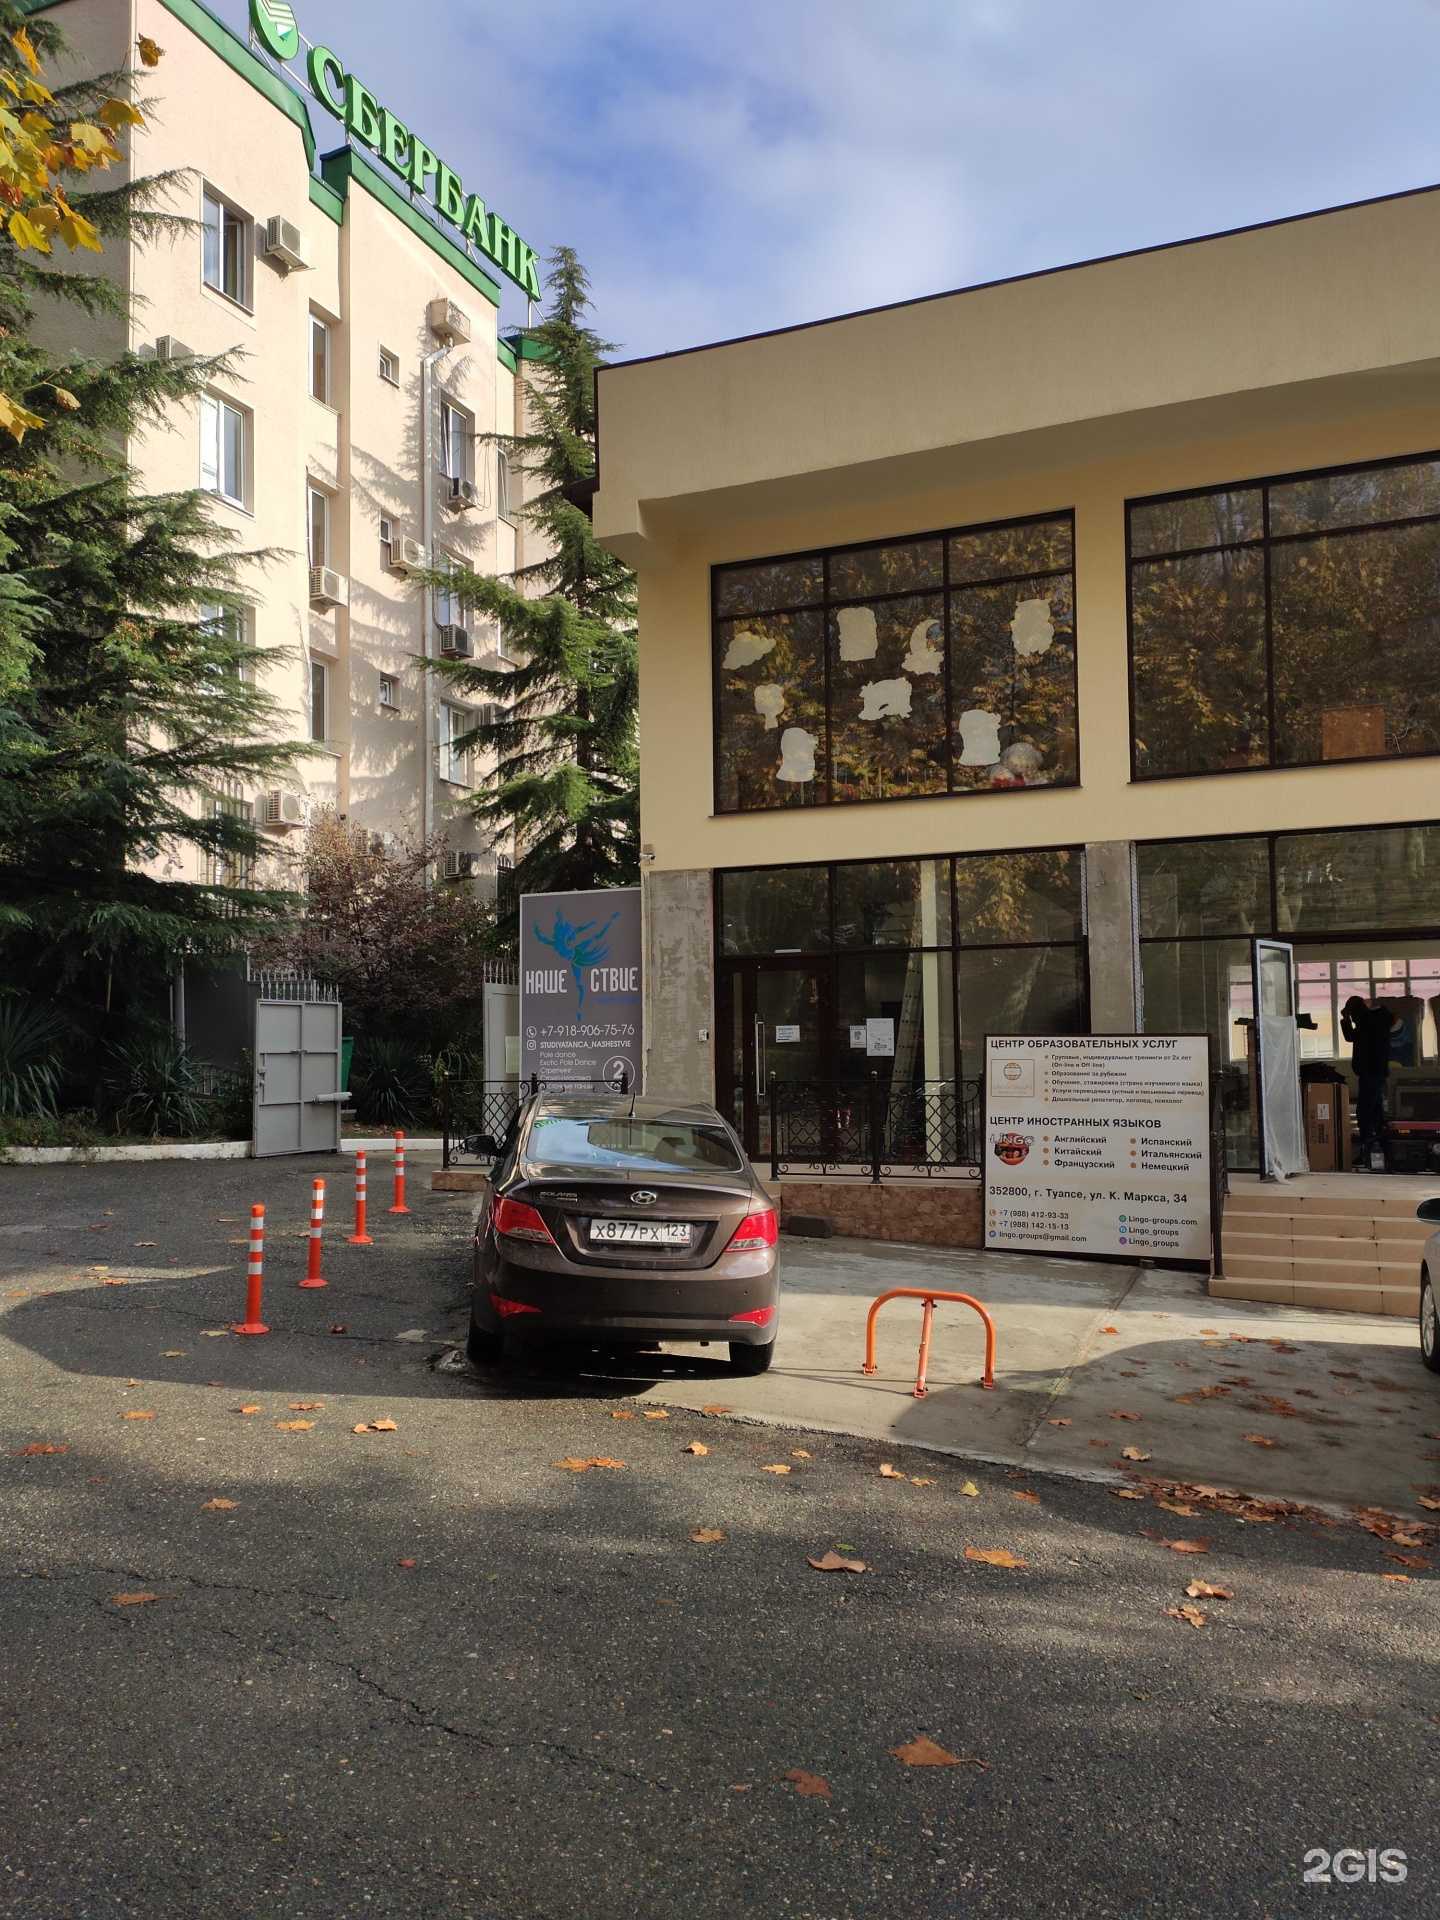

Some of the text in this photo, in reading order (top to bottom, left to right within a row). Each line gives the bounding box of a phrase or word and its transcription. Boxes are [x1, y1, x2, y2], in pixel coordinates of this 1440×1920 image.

[307, 45, 542, 301] СБЕРБАНК
[525, 969, 568, 994] НАШЕ
[540, 1024, 635, 1037] +7-918-906-75-76
[991, 1039, 1178, 1049] ЦЕНТР ОБРАЗОВАТЕЛЬНЫХ УСЛУГ
[612, 1060, 625, 1080] 2
[990, 1116, 1162, 1128] ЦЕНТР ИНОСТРАННЫХ ЯЗЫКОВ
[1054, 1135, 1107, 1144] Английский
[1141, 1137, 1192, 1147] Испанский
[1054, 1147, 1102, 1156] Китайский
[1141, 1149, 1202, 1159] Итальянский
[1054, 1159, 1115, 1169] Французский
[1141, 1162, 1190, 1171] Немецкий
[989, 1186, 1187, 1204] 352800, г. Туапсе, ул. К. Маркса, 34
[665, 1223, 687, 1237] 123
[1128, 1226, 1179, 1237] Lingo_groups
